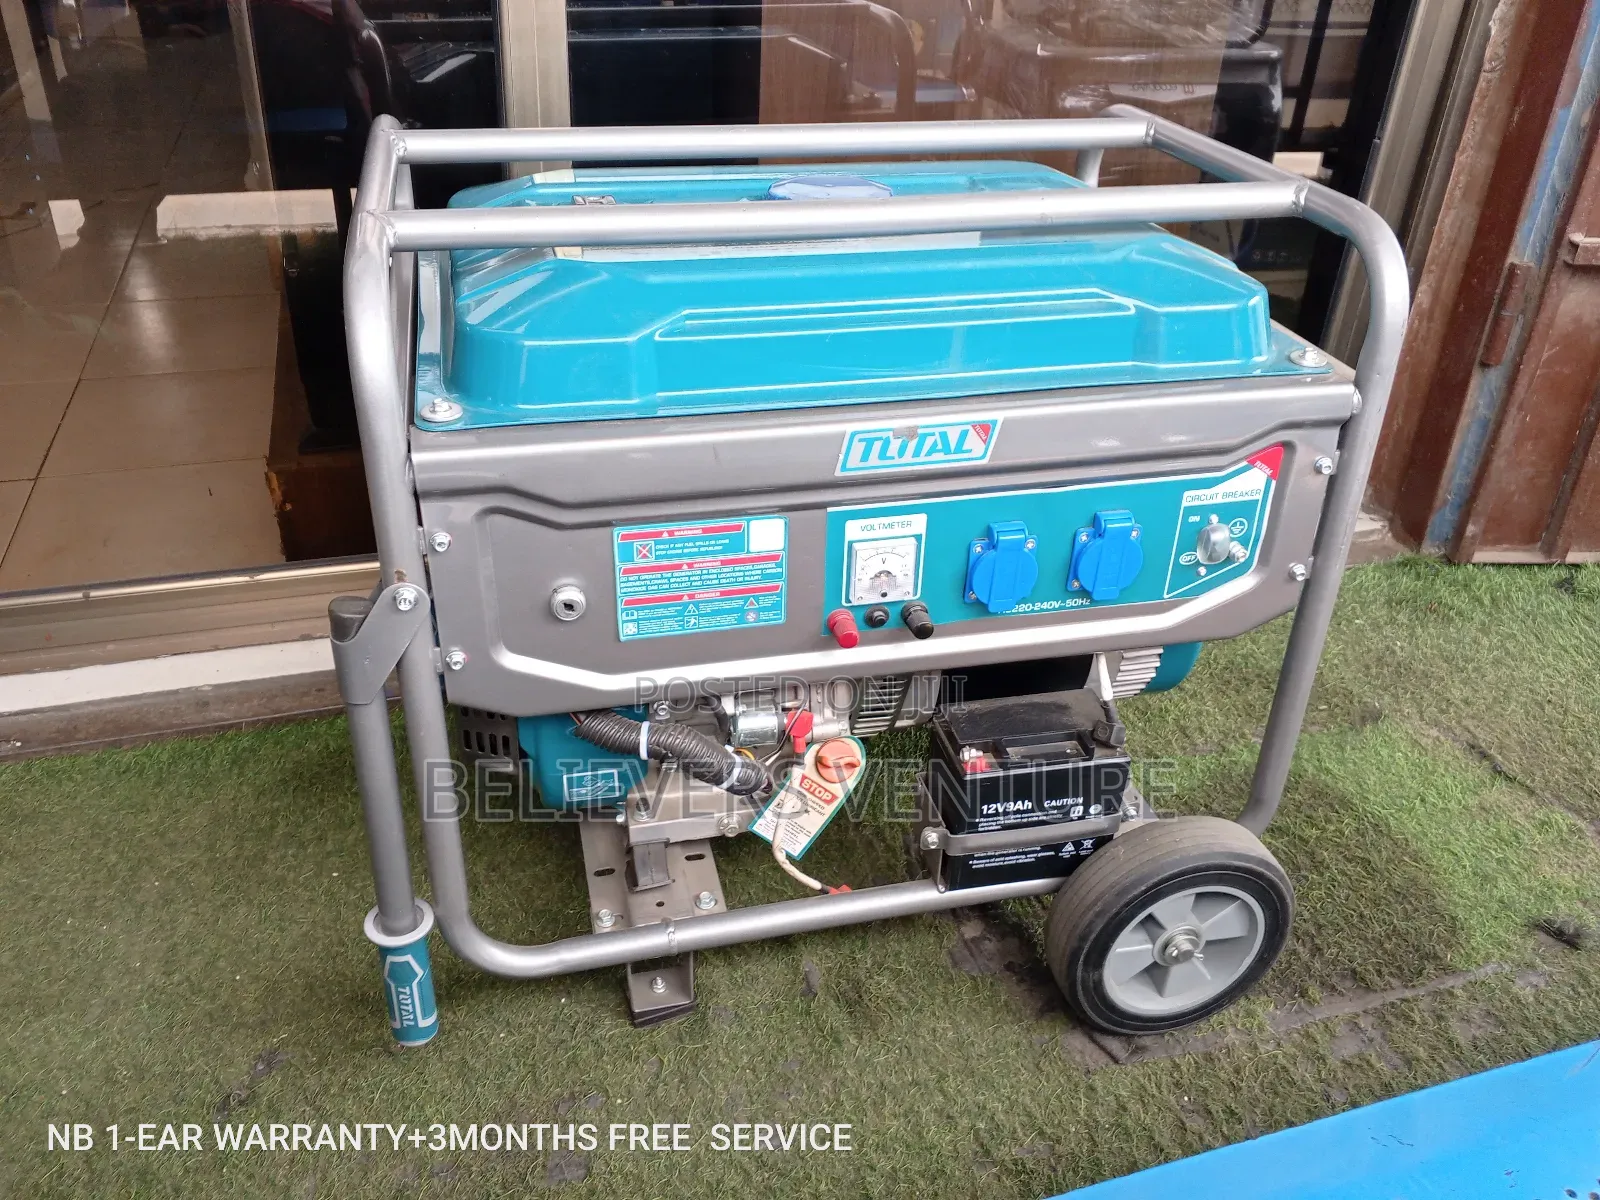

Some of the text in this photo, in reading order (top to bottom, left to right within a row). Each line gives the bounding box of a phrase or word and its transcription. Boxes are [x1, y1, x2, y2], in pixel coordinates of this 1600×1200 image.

[858, 429, 973, 463] TOTAL
[1253, 460, 1274, 476] TOTAL
[1185, 488, 1262, 503] CIRCUIT BREAKER
[860, 520, 913, 532] VOLTMETER
[1188, 515, 1200, 523] ON
[1182, 554, 1196, 562] OFF
[998, 598, 1091, 614] 220-240V~50Hz
[801, 778, 833, 801] STOP
[981, 796, 1084, 815] 12V9Ah CAUTION
[397, 986, 415, 1028] TOTAL
